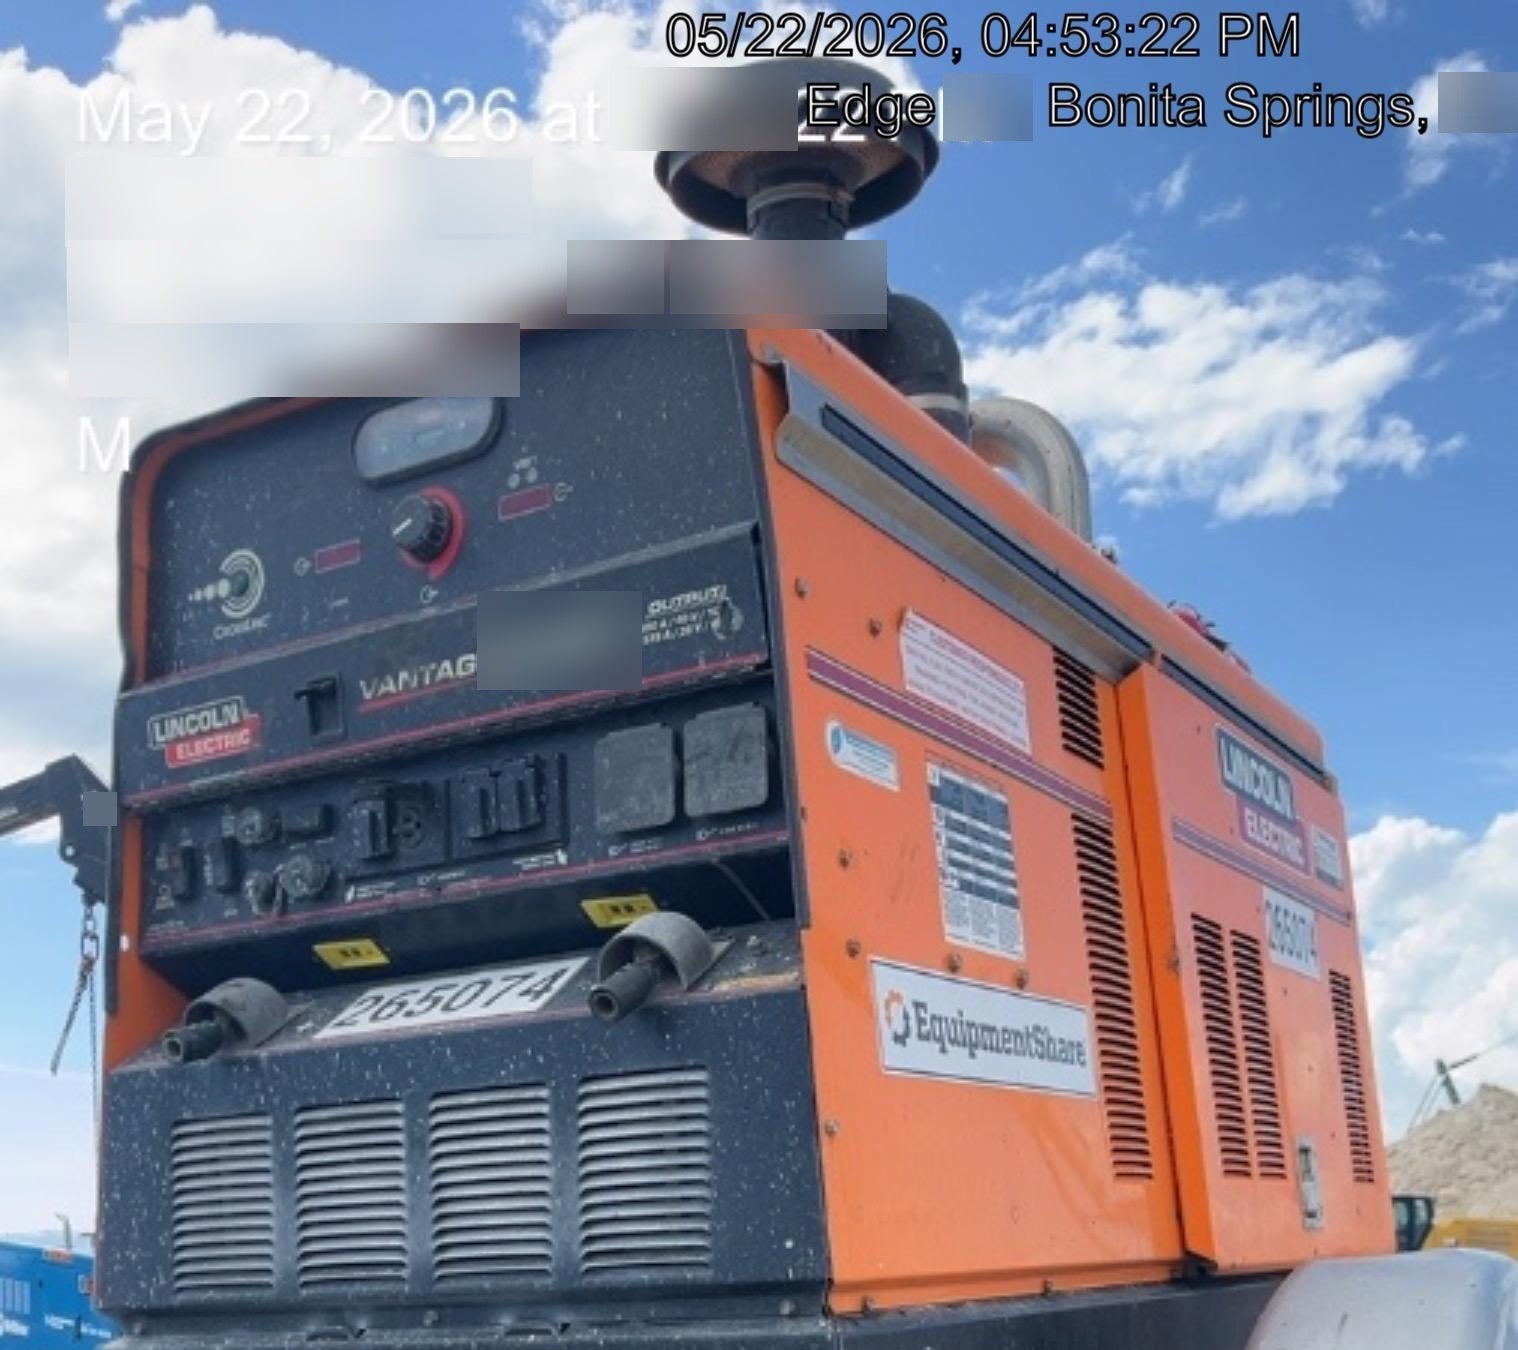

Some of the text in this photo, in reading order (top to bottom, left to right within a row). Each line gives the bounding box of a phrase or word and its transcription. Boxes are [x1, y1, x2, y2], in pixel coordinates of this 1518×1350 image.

[359, 653, 477, 700] VANTAG
[152, 702, 240, 741] LINCOLN
[174, 728, 250, 760] ELECTRIC
[1220, 735, 1293, 820] LINCOLN
[1244, 806, 1305, 868] ELECTRIC
[330, 966, 570, 1027] 265074
[912, 1000, 1086, 1067] EquipmentShare
